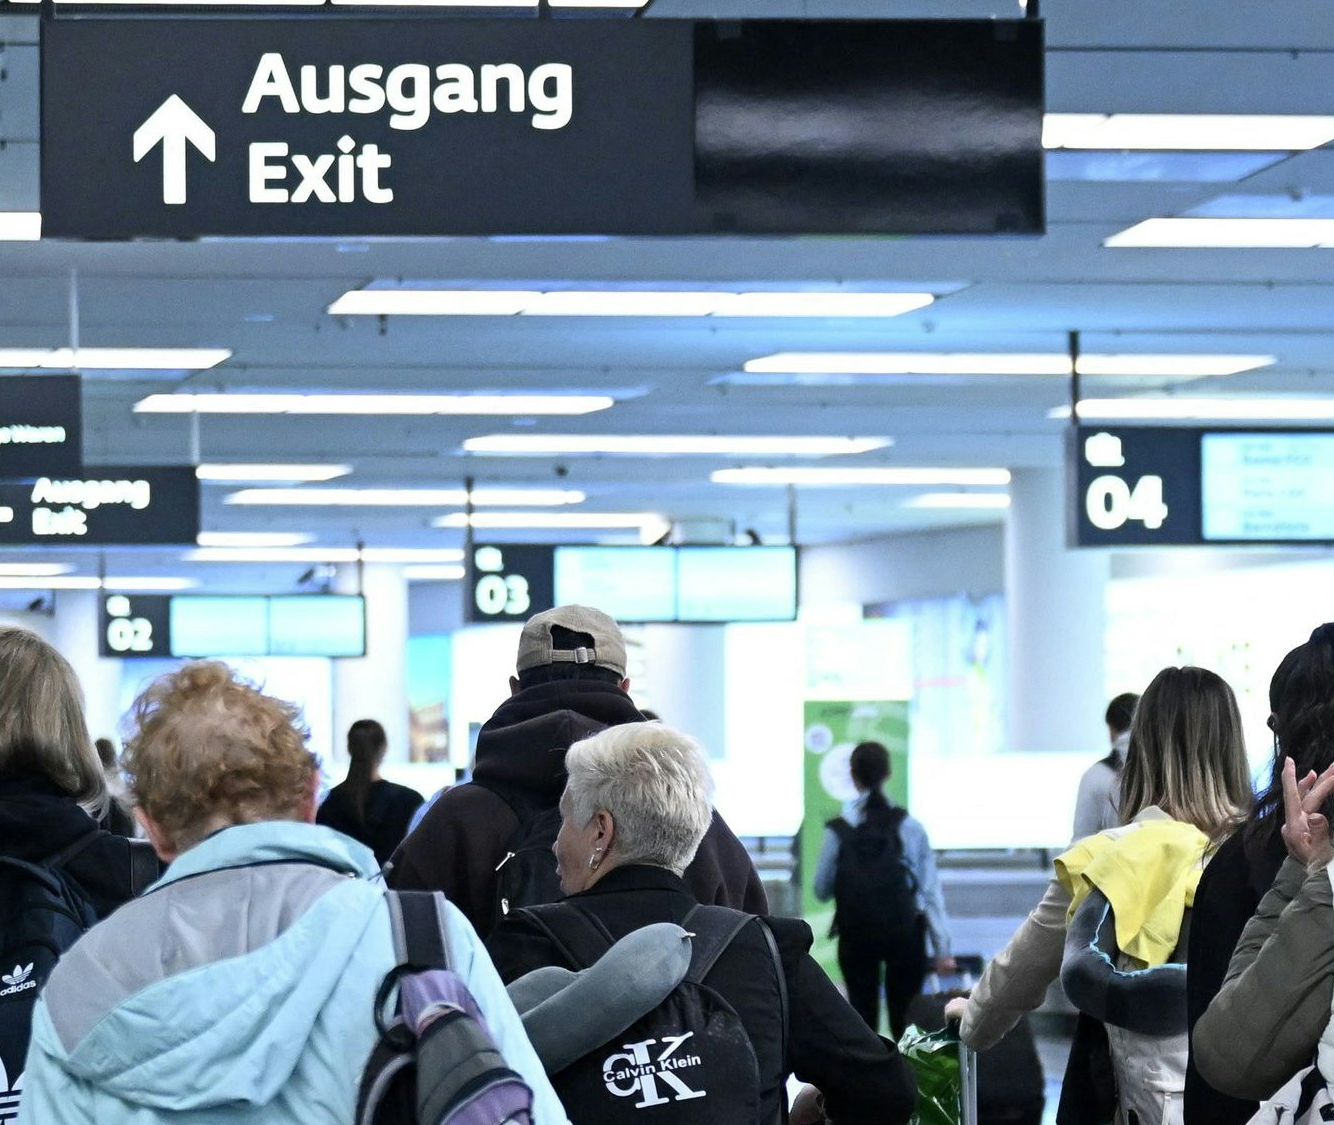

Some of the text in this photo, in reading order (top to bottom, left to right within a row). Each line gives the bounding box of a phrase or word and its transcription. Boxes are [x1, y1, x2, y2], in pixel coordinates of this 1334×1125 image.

[242, 53, 573, 131] Ausgang
[248, 135, 394, 204] Exit
[1085, 474, 1168, 530] 04
[474, 574, 530, 615] 03
[107, 617, 153, 652] 02
[0, 979, 37, 997] adidas
[603, 1055, 702, 1082] Calvin Klein
